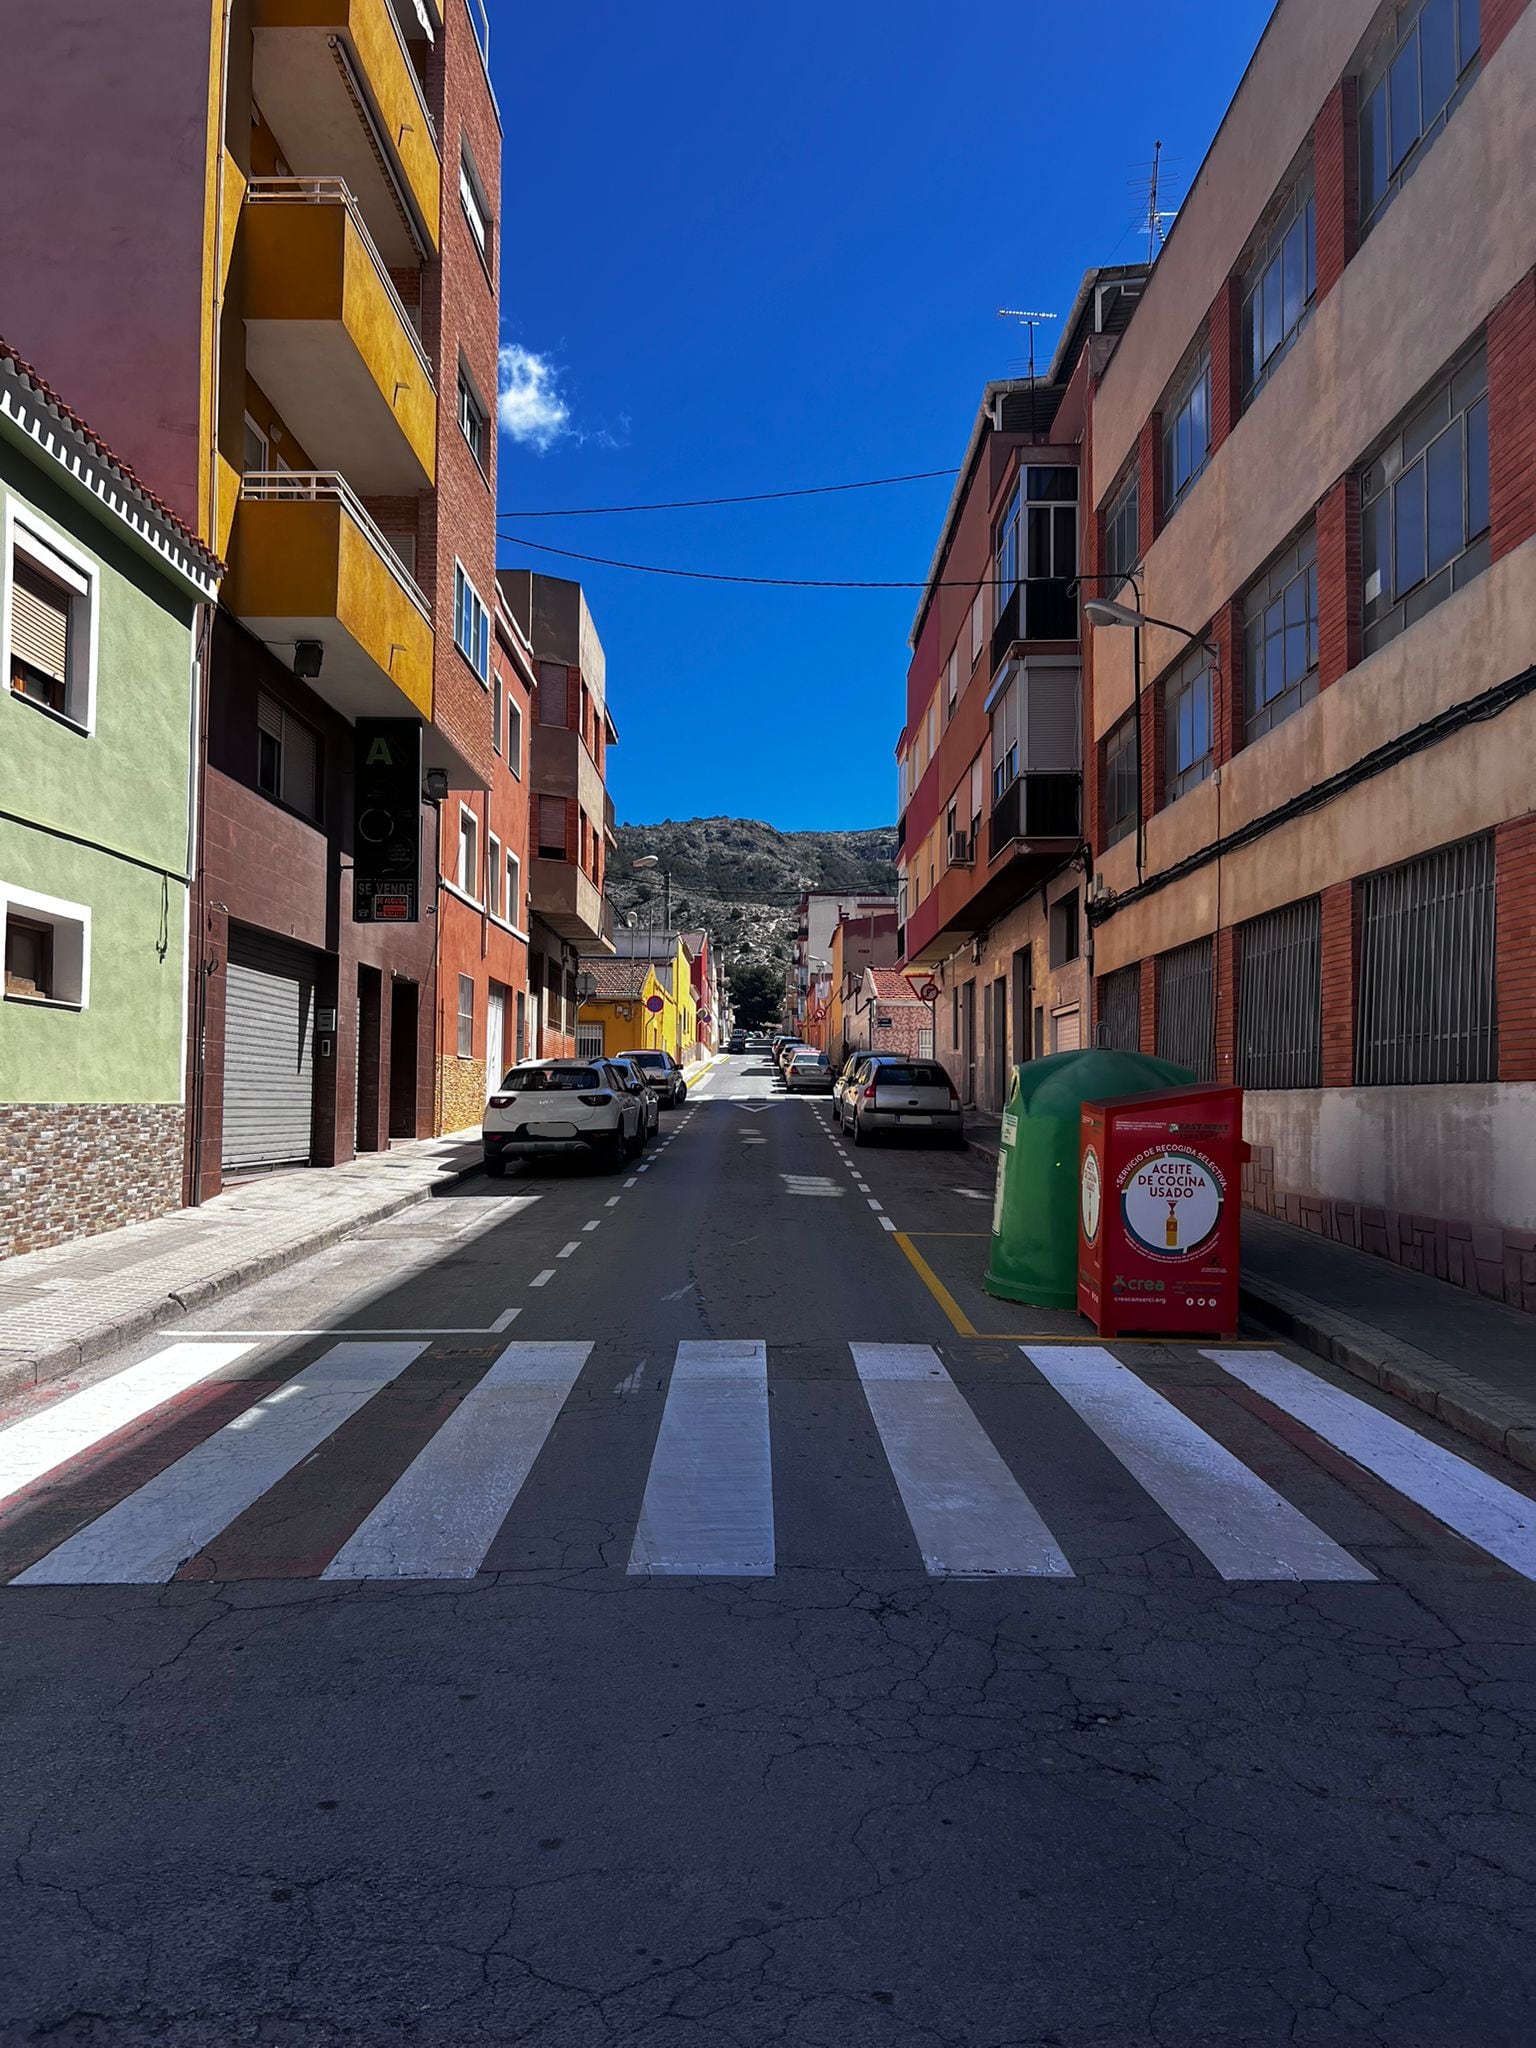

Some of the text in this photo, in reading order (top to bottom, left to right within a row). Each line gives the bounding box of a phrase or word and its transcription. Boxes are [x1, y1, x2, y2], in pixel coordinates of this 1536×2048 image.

[358, 883, 413, 896] SE VENDE
[1116, 1154, 1144, 1185] SERVICIO
[1143, 1147, 1156, 1158] DE
[1155, 1144, 1197, 1157] RECOGIDA
[1196, 1152, 1228, 1187] SELECTIVA
[1152, 1164, 1192, 1175] ACEITE
[1138, 1175, 1206, 1187] DE COCINA
[1150, 1187, 1194, 1198] USADO
[1128, 1278, 1165, 1292] crea
